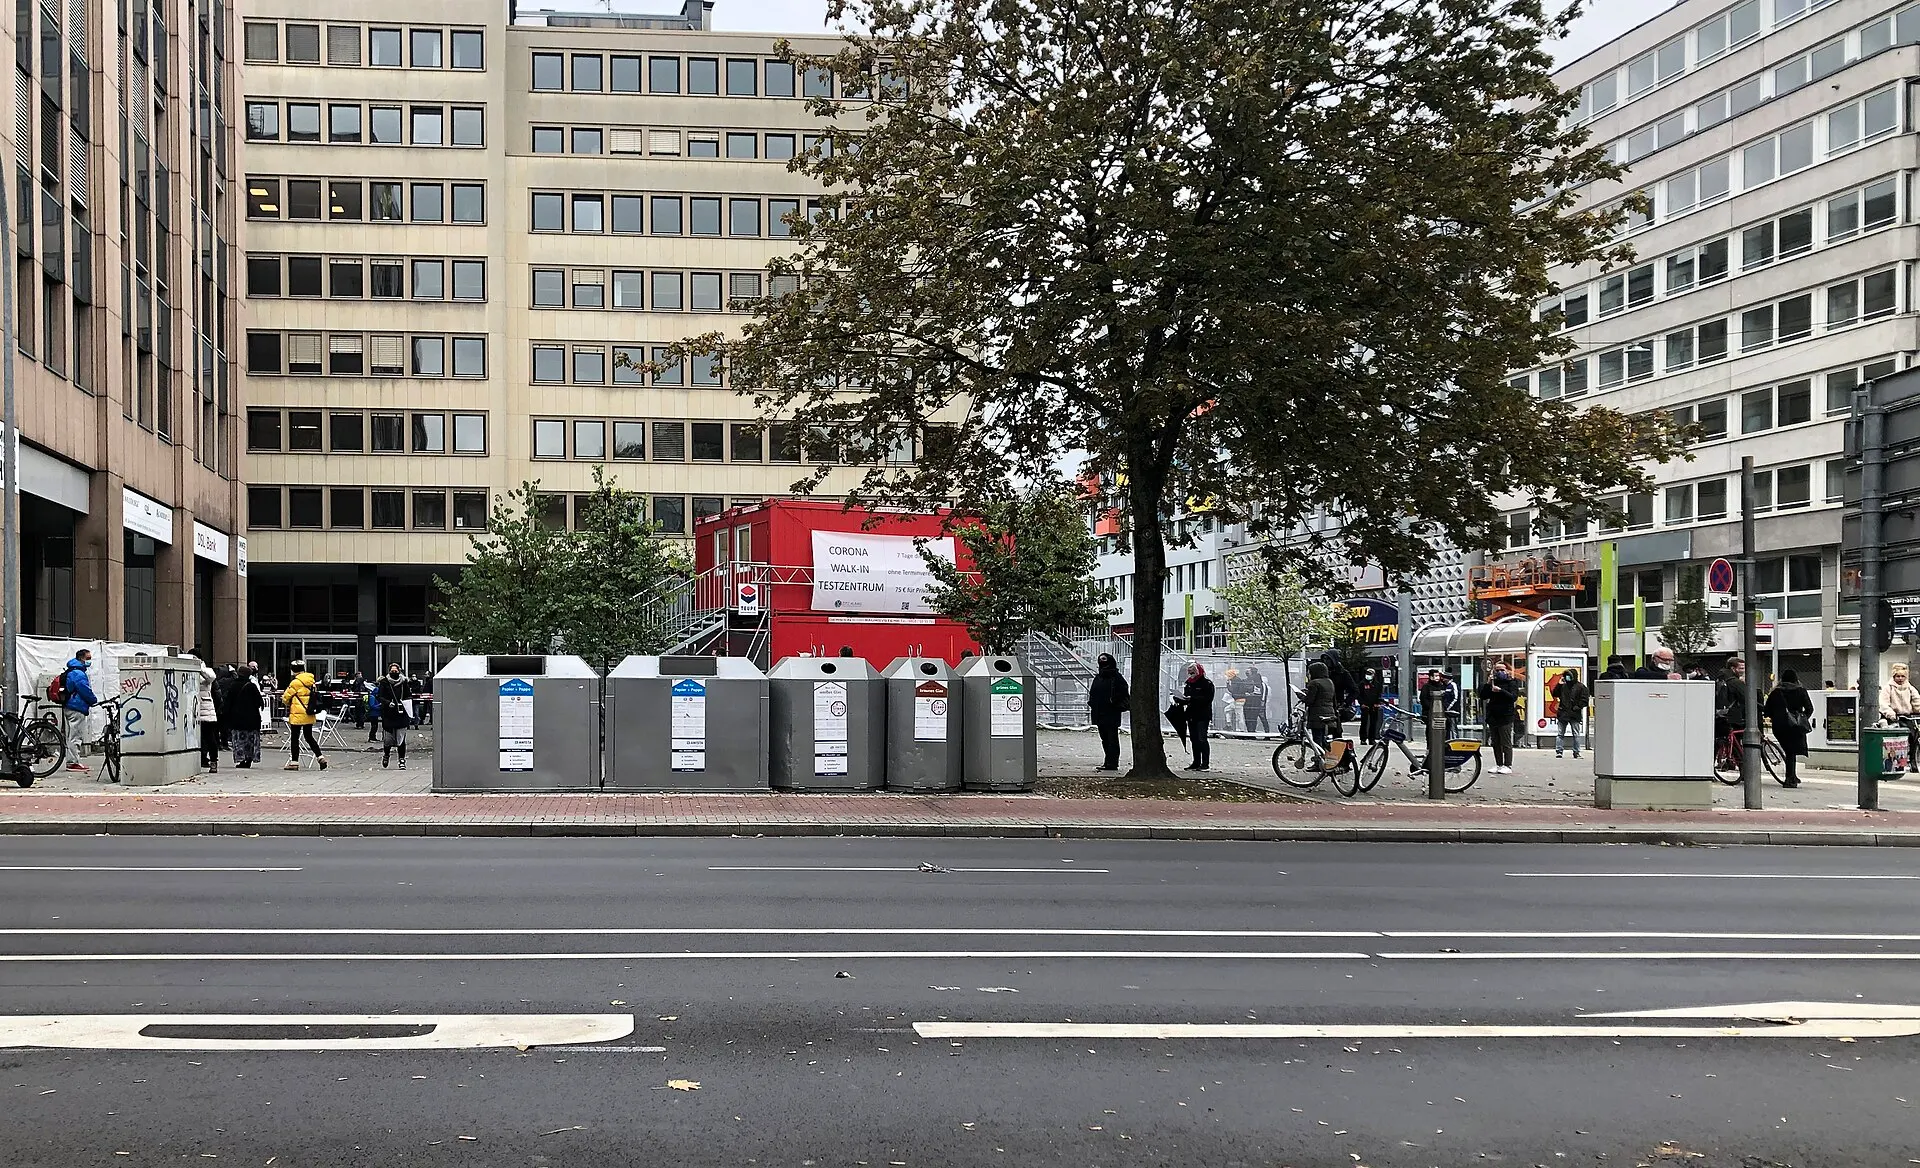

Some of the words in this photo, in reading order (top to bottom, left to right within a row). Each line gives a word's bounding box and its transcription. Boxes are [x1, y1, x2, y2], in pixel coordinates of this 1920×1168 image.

[197, 532, 206, 548] DSL
[206, 536, 217, 553] Bank
[828, 546, 869, 557] CORONA
[830, 563, 870, 574] WALK-IN
[818, 580, 884, 592] TESTZENTRUM
